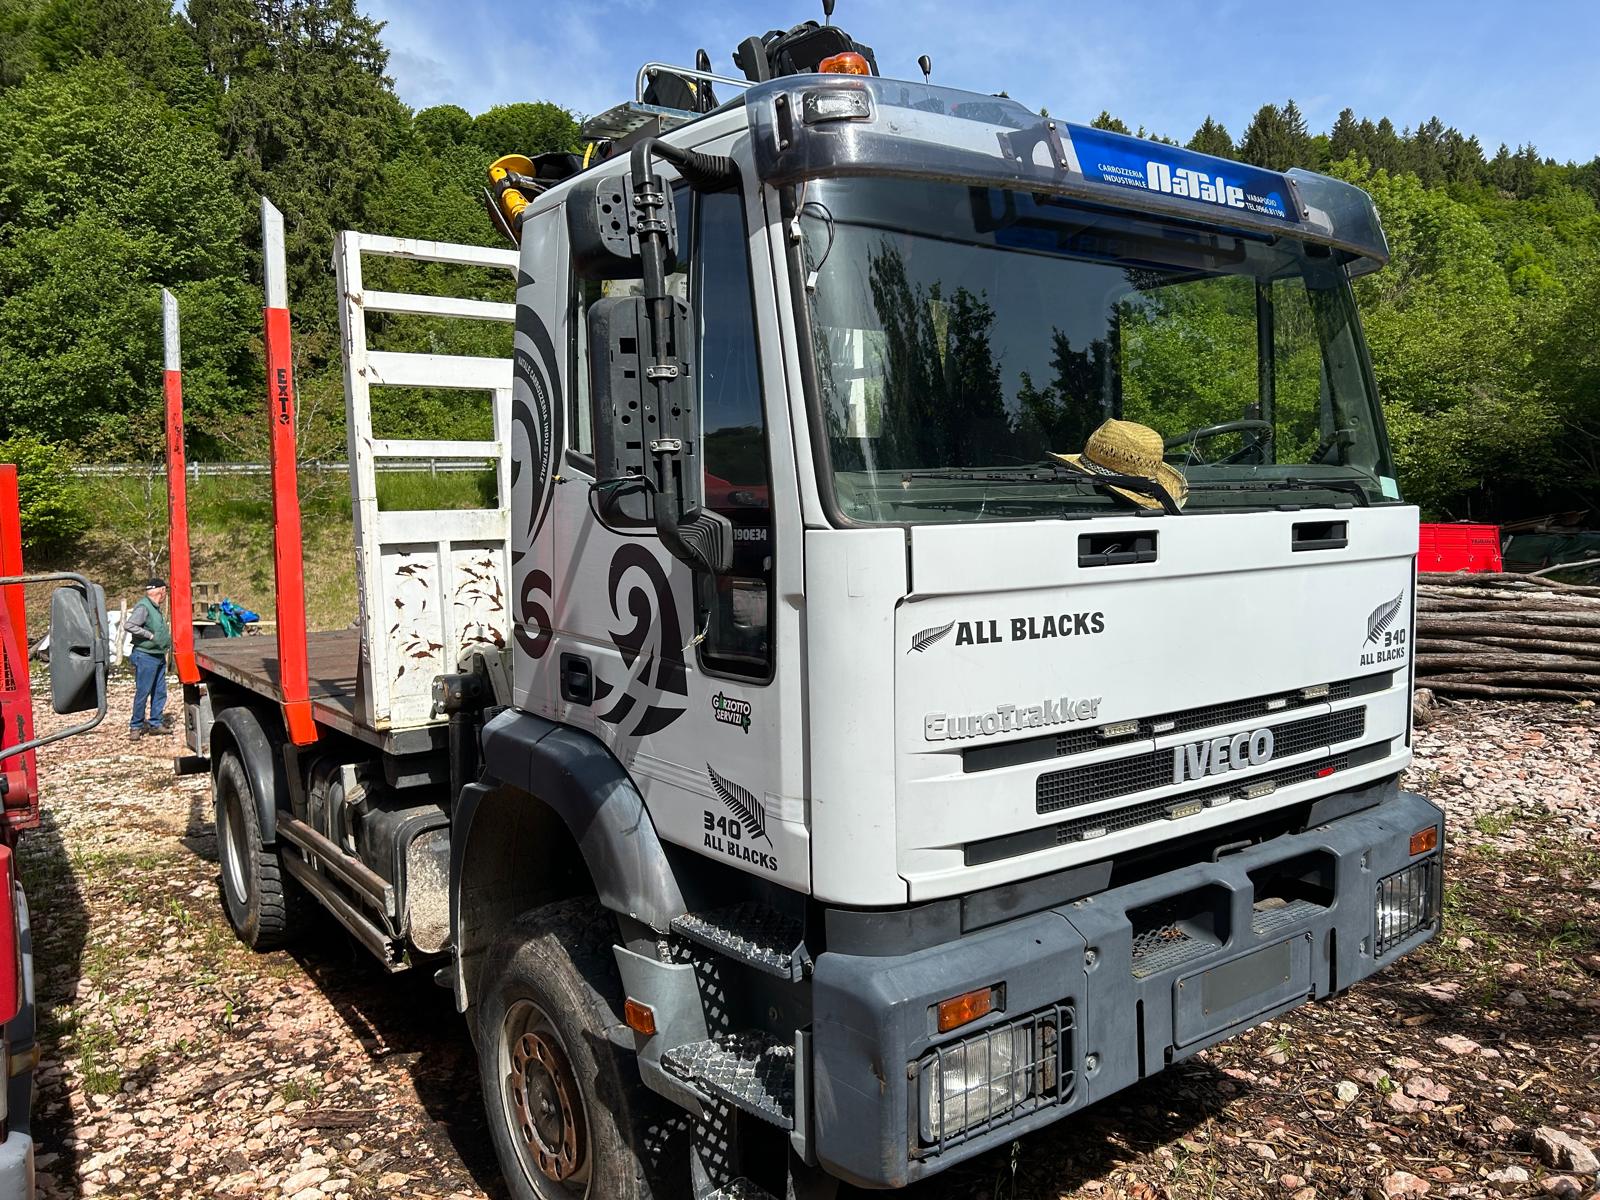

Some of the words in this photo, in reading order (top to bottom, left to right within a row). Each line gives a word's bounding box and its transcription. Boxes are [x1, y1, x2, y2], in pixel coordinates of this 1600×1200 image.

[1097, 163, 1144, 178] CARROZZERIA
[1103, 173, 1147, 188] INDUSTRIALE
[518, 355, 531, 374] NATALE
[530, 369, 548, 421] CARROZZERIA
[540, 422, 549, 484] INDUSTRIALE
[733, 528, 767, 541] 190E34
[955, 620, 1002, 646] ALL
[1010, 611, 1105, 642] BLACKS
[1384, 628, 1406, 647] 340
[1360, 652, 1375, 666] ALL
[1377, 646, 1405, 663] BLACKS
[716, 709, 742, 724] SERVIZI
[924, 696, 1103, 742] EuroTrakker
[1172, 728, 1275, 785] IVECO
[704, 810, 741, 840] 340
[704, 832, 724, 852] ALL
[727, 840, 778, 871] BLACKS
